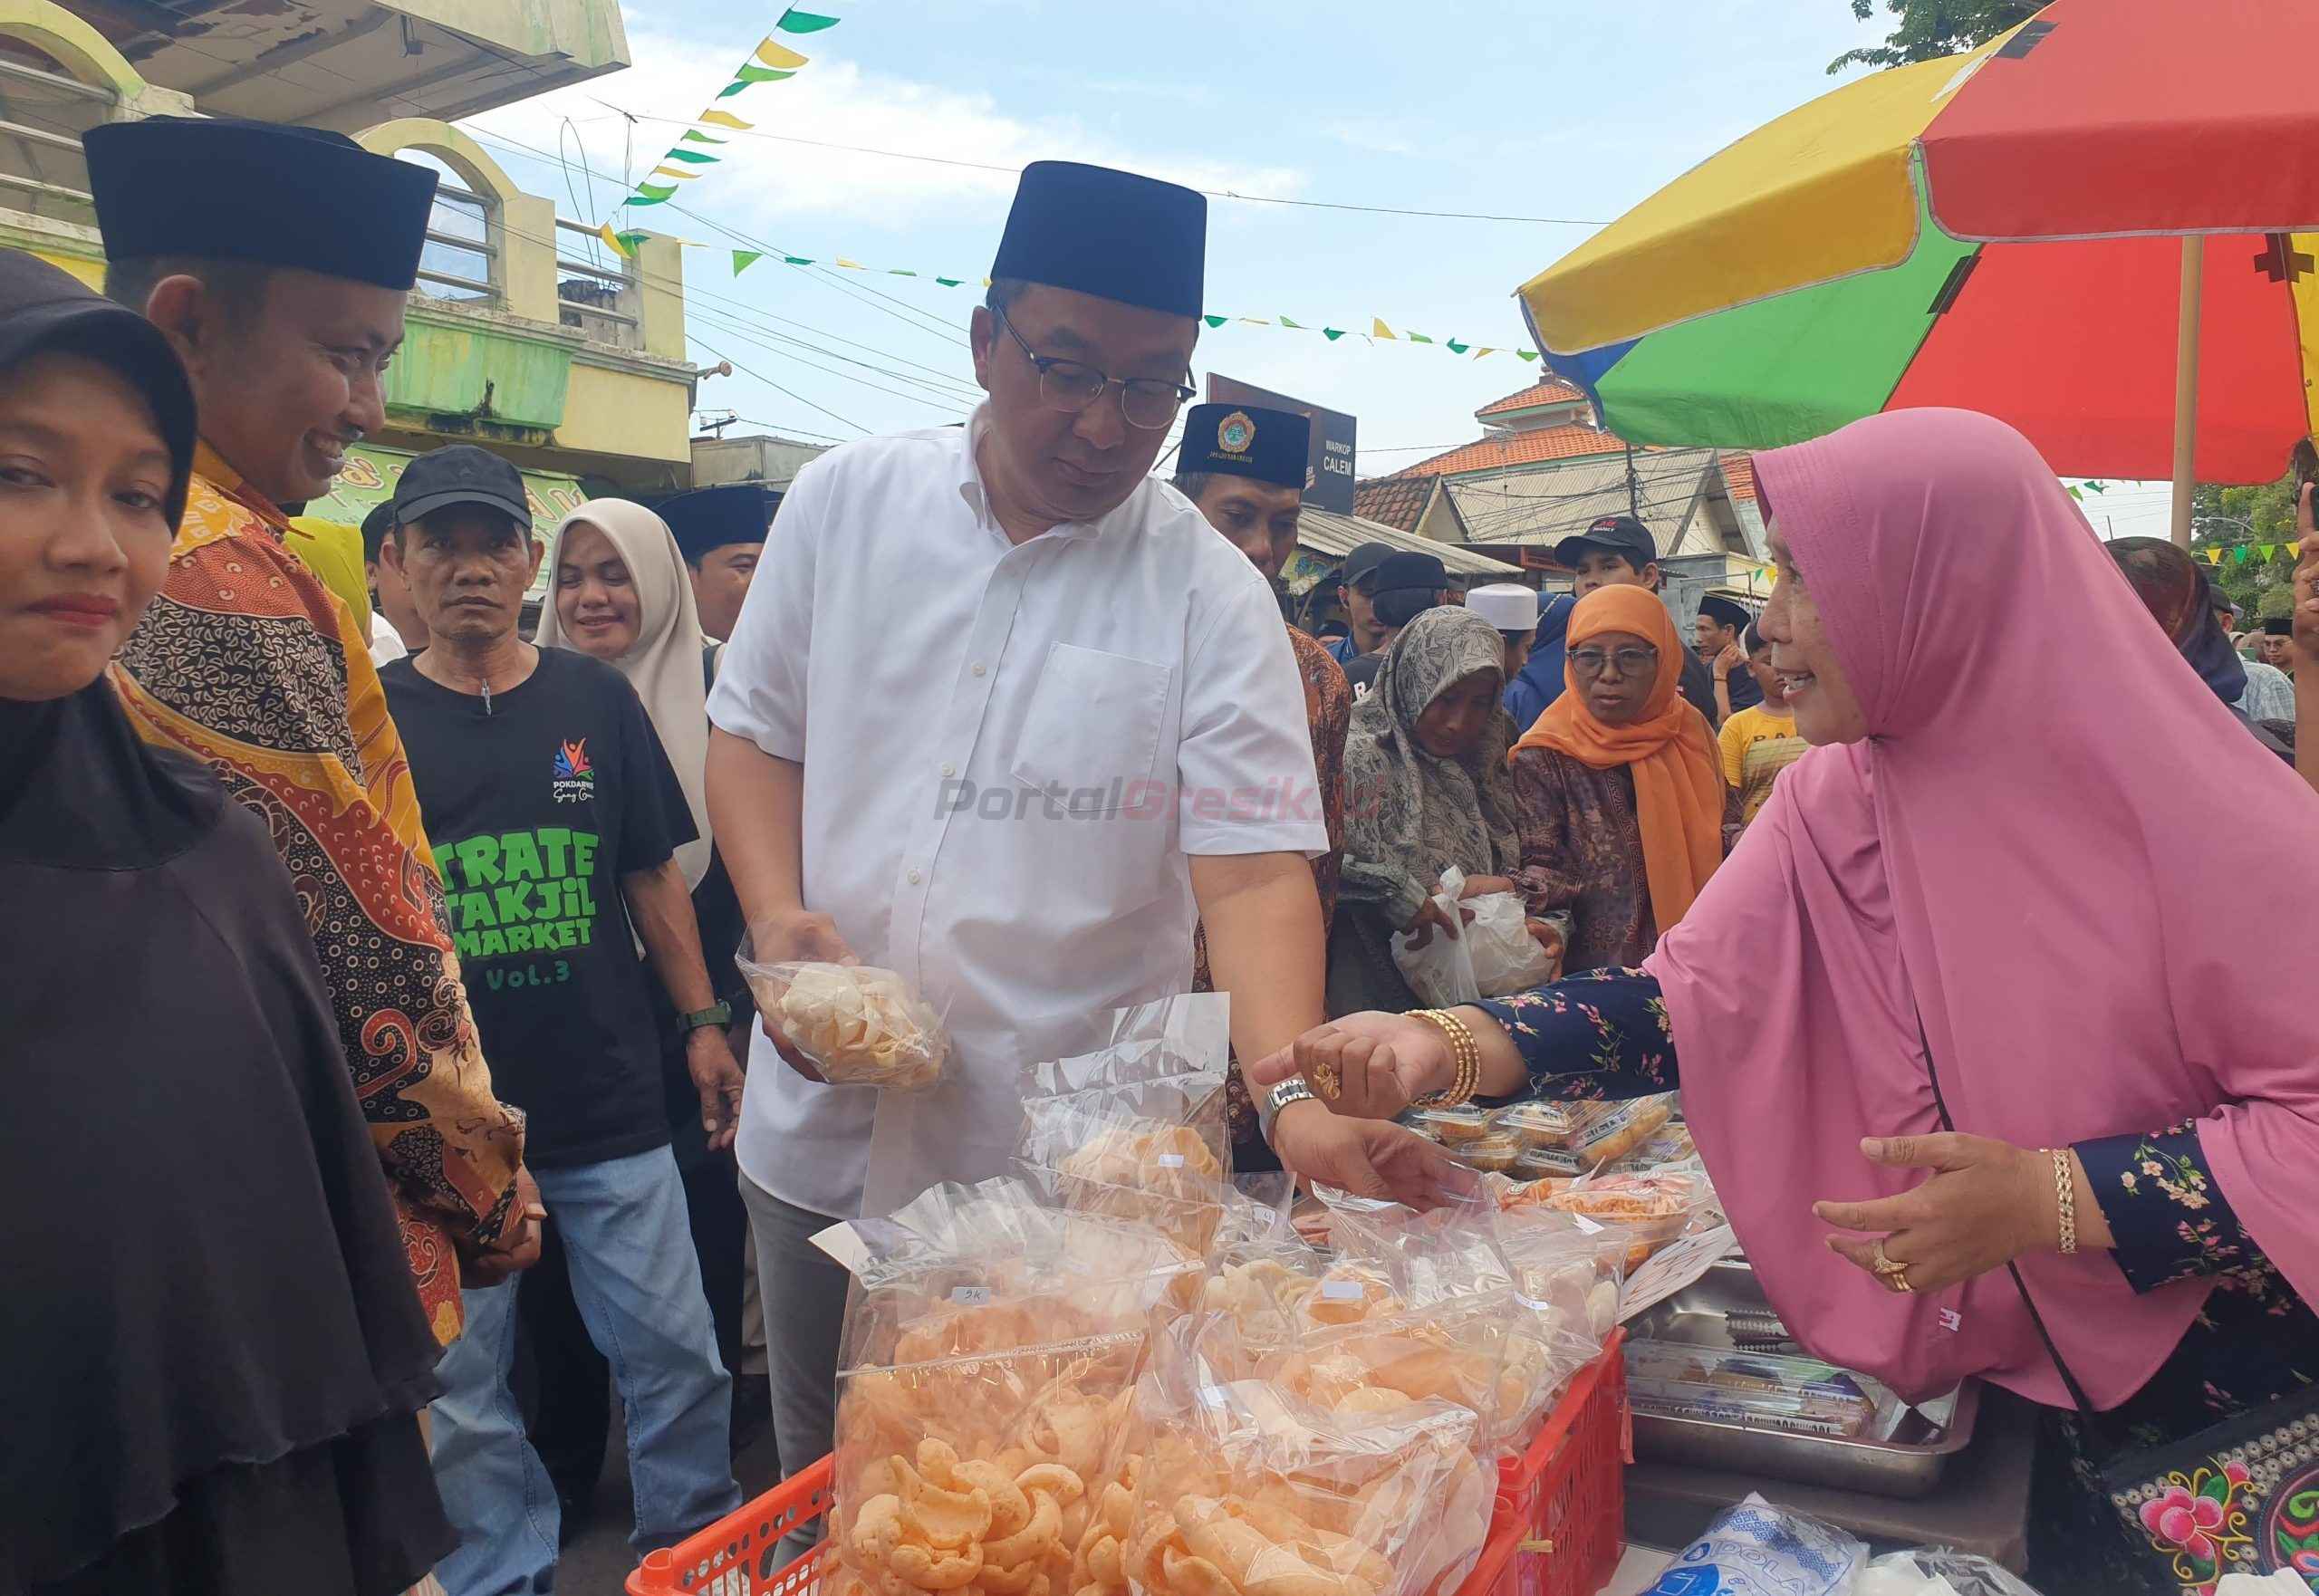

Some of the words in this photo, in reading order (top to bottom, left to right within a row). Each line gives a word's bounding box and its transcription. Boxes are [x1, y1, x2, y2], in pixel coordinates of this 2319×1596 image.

[1325, 439, 1352, 456] WARKOP
[1323, 456, 1352, 476] CALEM
[454, 918, 592, 958] MARKET
